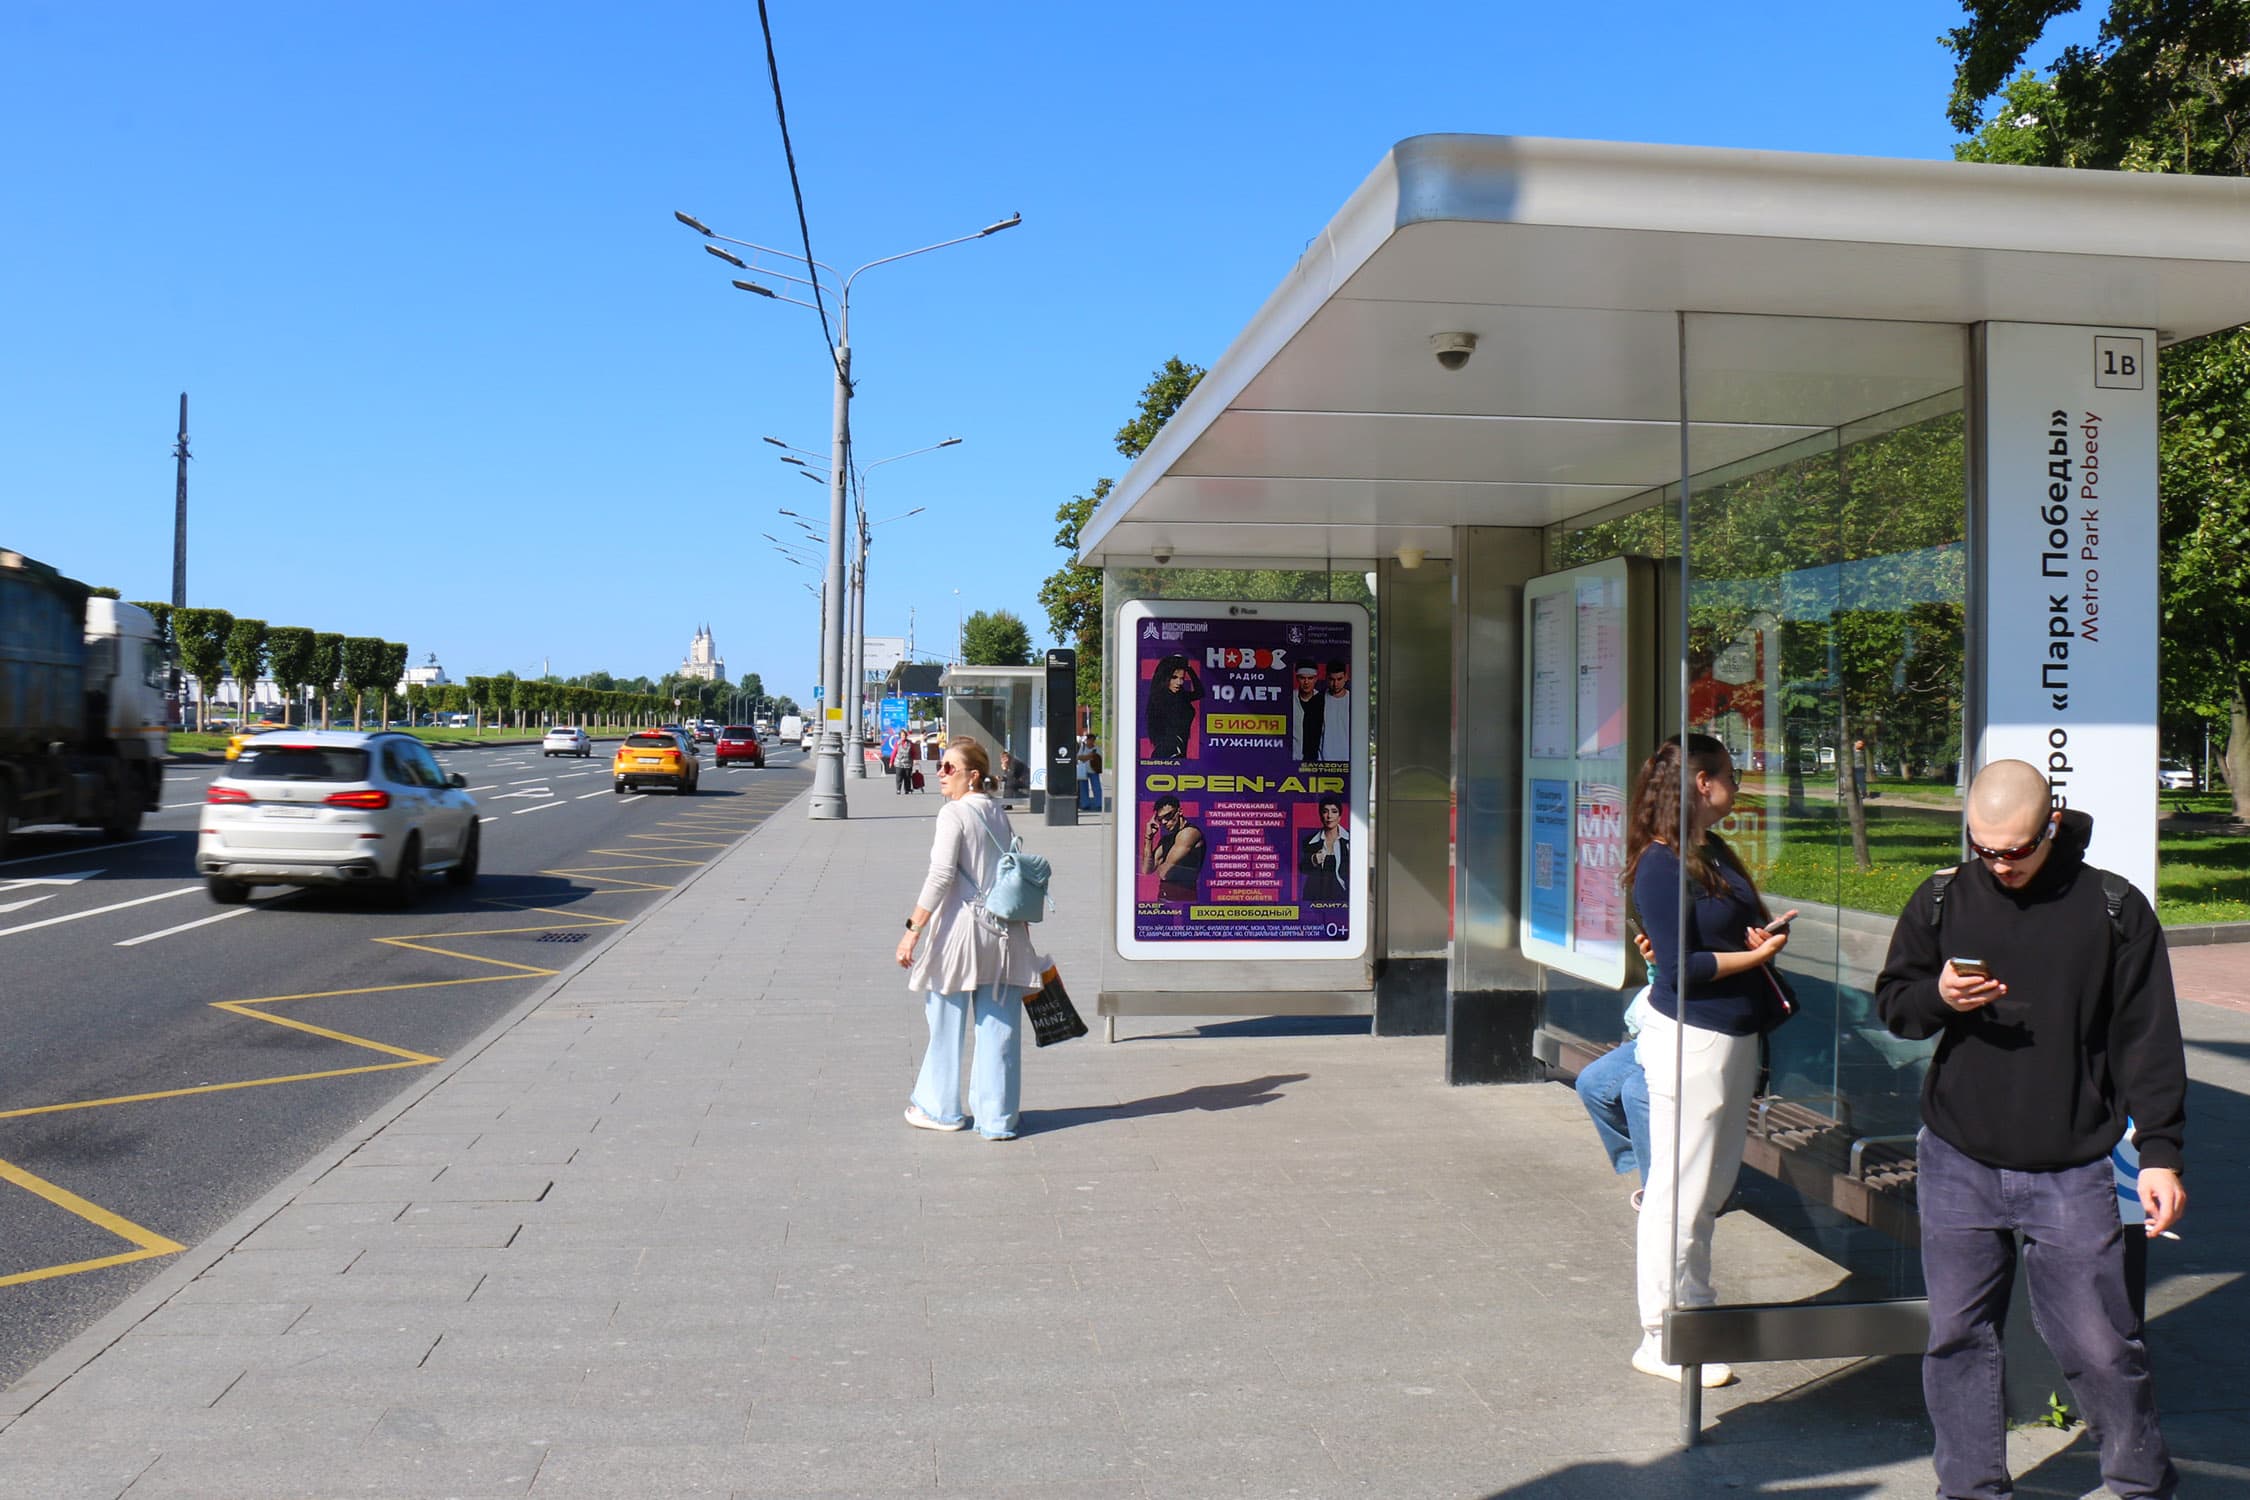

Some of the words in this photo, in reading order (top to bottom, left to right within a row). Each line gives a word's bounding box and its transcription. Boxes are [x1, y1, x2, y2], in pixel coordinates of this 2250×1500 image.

[2080, 411, 2103, 500] Pobedy
[2041, 408, 2073, 578] Победы»
[2081, 508, 2100, 564] Park
[2081, 568, 2100, 643] Metro
[2042, 593, 2074, 712] «Парк
[1229, 672, 1265, 681] РАДИО
[1212, 685, 1235, 703] 10
[1239, 686, 1282, 701] ЛЕТ
[1214, 719, 1224, 729] 5
[1228, 719, 1280, 730] ИЮЛЯ
[1208, 737, 1284, 748] ЛУЖНИКИ
[2048, 727, 2074, 809] етро
[1145, 774, 1345, 794] OPEN-AIR
[1197, 909, 1225, 917] ВХОД
[1227, 908, 1292, 917] СВОБОДНЫЙ
[1326, 922, 1349, 937] 0+
